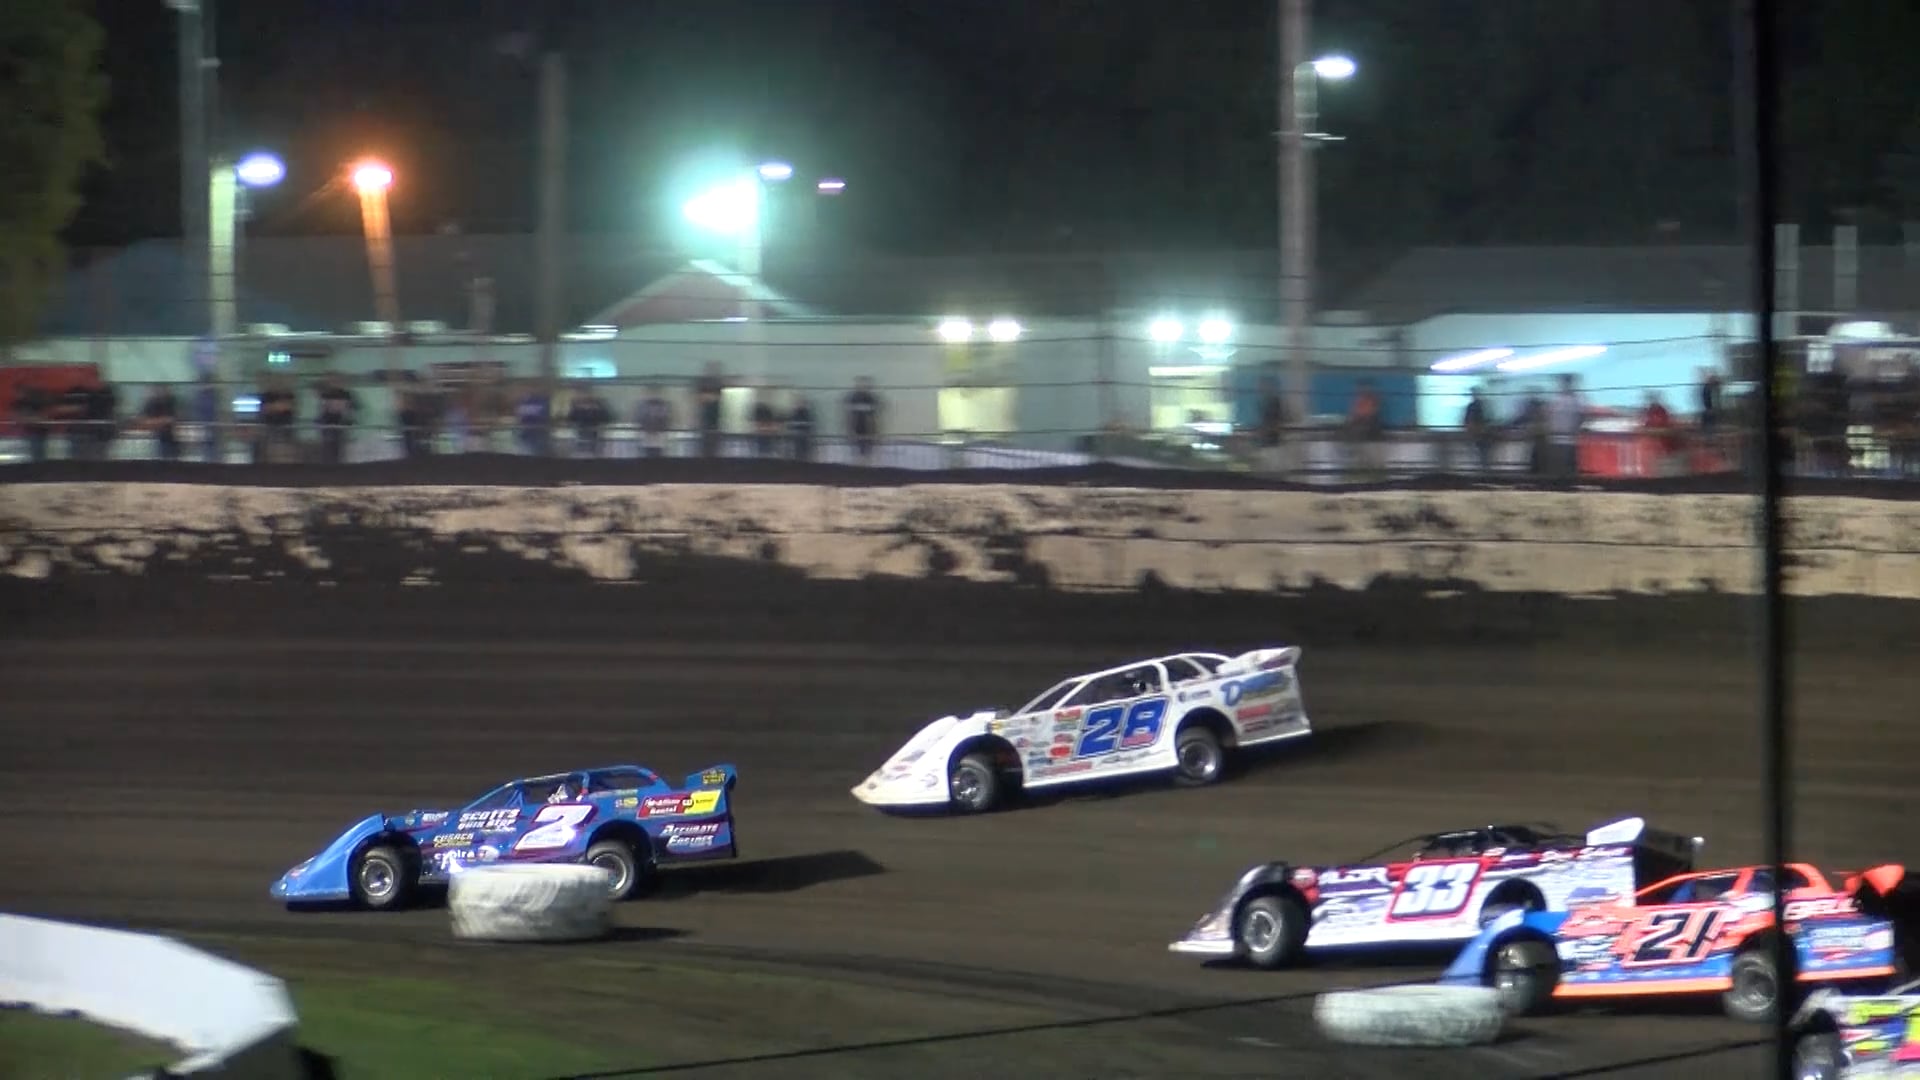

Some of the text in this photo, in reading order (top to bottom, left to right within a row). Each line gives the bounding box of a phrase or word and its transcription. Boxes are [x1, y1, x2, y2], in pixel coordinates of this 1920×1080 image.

[1077, 697, 1170, 760] 28
[513, 804, 594, 851] 2
[1391, 862, 1480, 915] 33
[1632, 908, 1720, 962] 21
